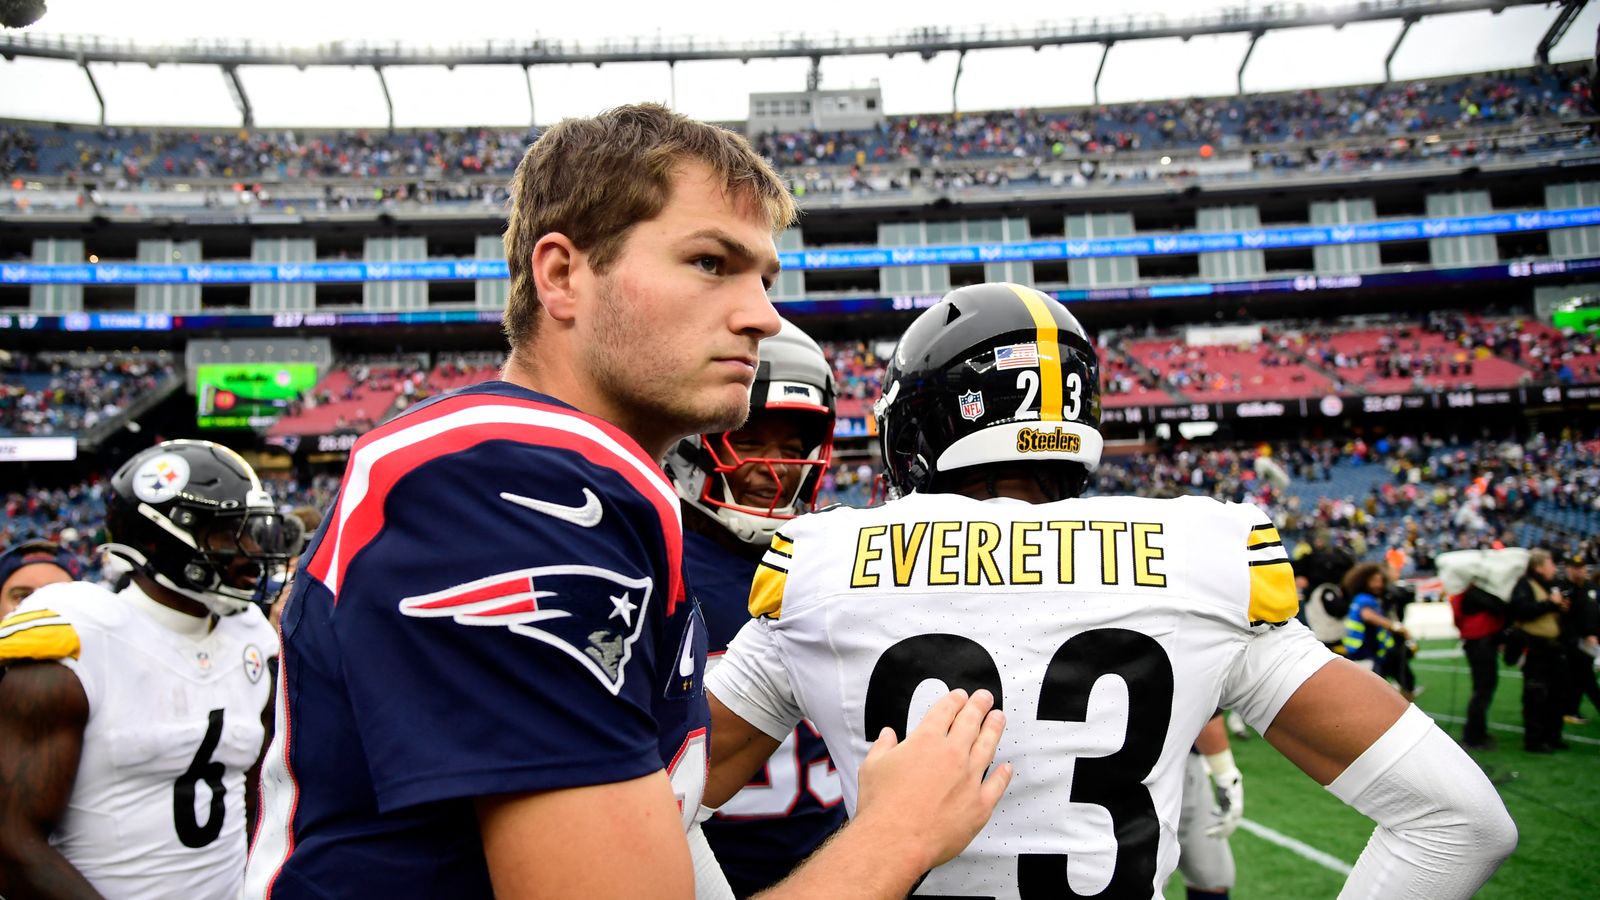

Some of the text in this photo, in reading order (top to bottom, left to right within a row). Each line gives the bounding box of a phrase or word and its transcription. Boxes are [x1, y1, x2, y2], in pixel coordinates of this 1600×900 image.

[963, 403, 981, 416] NFL
[1017, 427, 1081, 453] Steelers
[850, 520, 1167, 589] EVERETTE
[174, 708, 227, 848] 6
